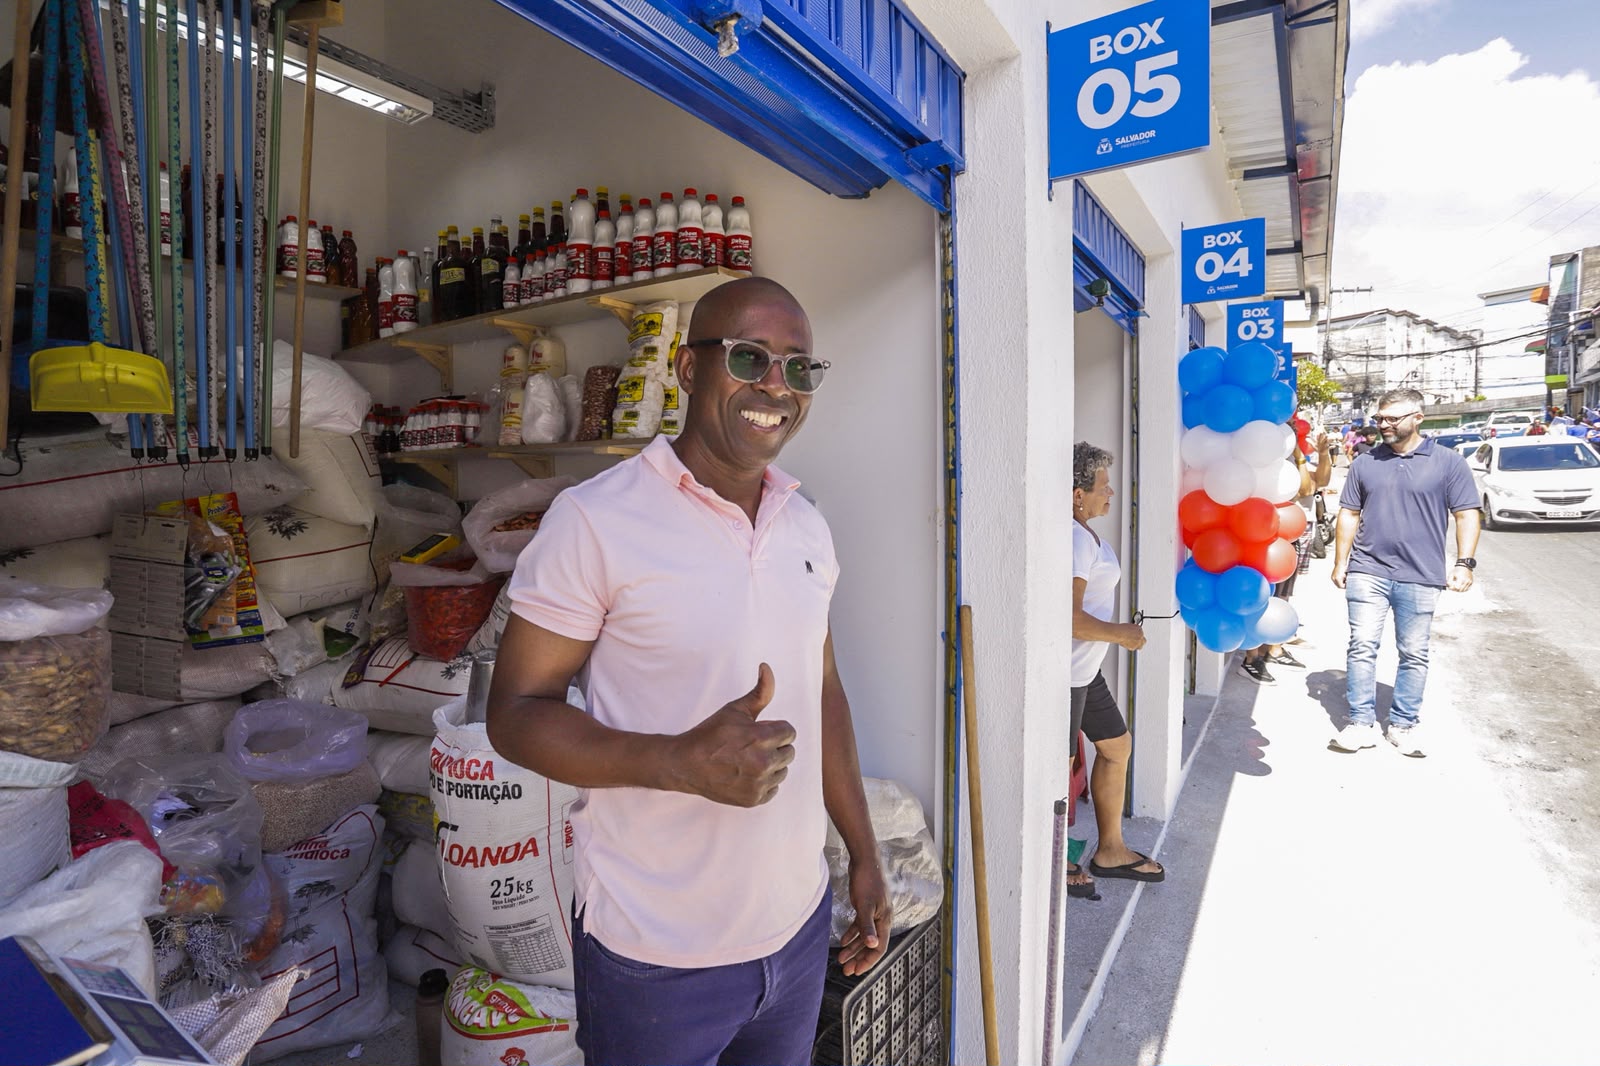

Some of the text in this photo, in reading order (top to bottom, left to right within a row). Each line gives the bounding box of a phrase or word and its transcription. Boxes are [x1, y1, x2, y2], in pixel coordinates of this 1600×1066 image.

[1089, 16, 1165, 64] BOX
[1076, 50, 1181, 130] 05
[1115, 130, 1156, 145] SALVADOR
[1203, 230, 1243, 249] BOX
[1195, 247, 1253, 282] 04
[1242, 307, 1270, 318] BOX
[1237, 318, 1275, 341] 03
[440, 837, 539, 868] LOANDA
